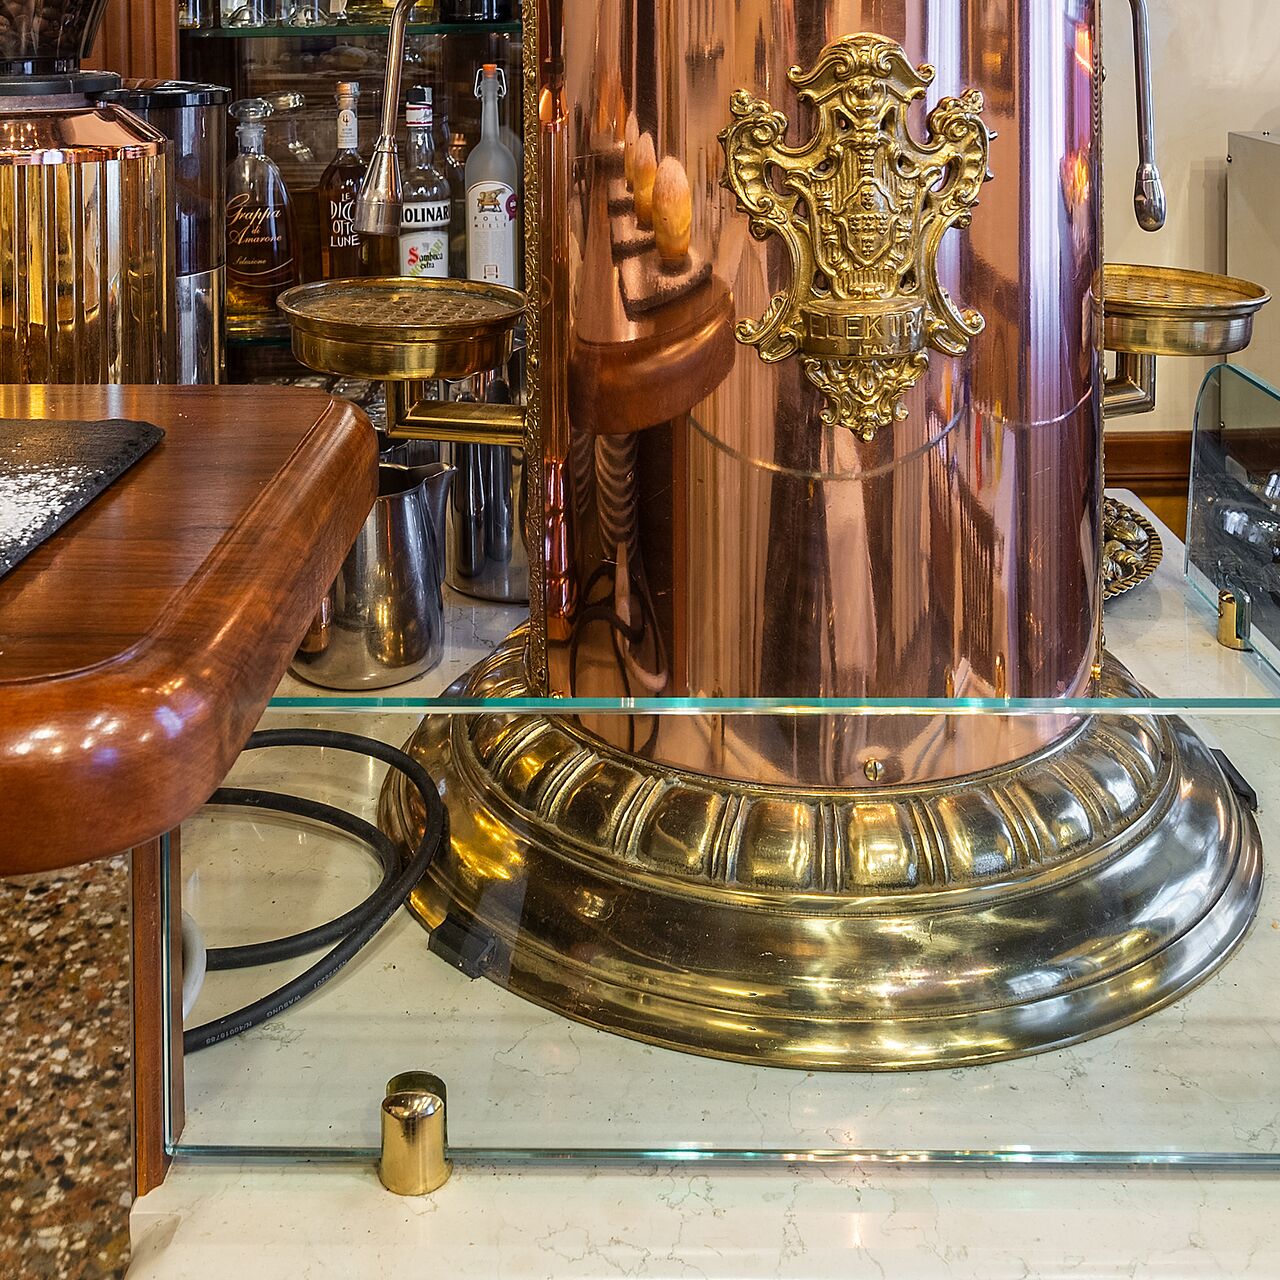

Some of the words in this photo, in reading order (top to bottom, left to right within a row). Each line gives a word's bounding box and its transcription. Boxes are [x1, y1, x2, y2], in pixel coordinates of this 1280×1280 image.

[342, 192, 350, 202] LE
[226, 193, 282, 226] Grappa
[226, 224, 282, 246] Amarone
[330, 234, 360, 248] LUNE
[408, 246, 443, 266] Sambuca
[858, 343, 896, 356] ITALY
